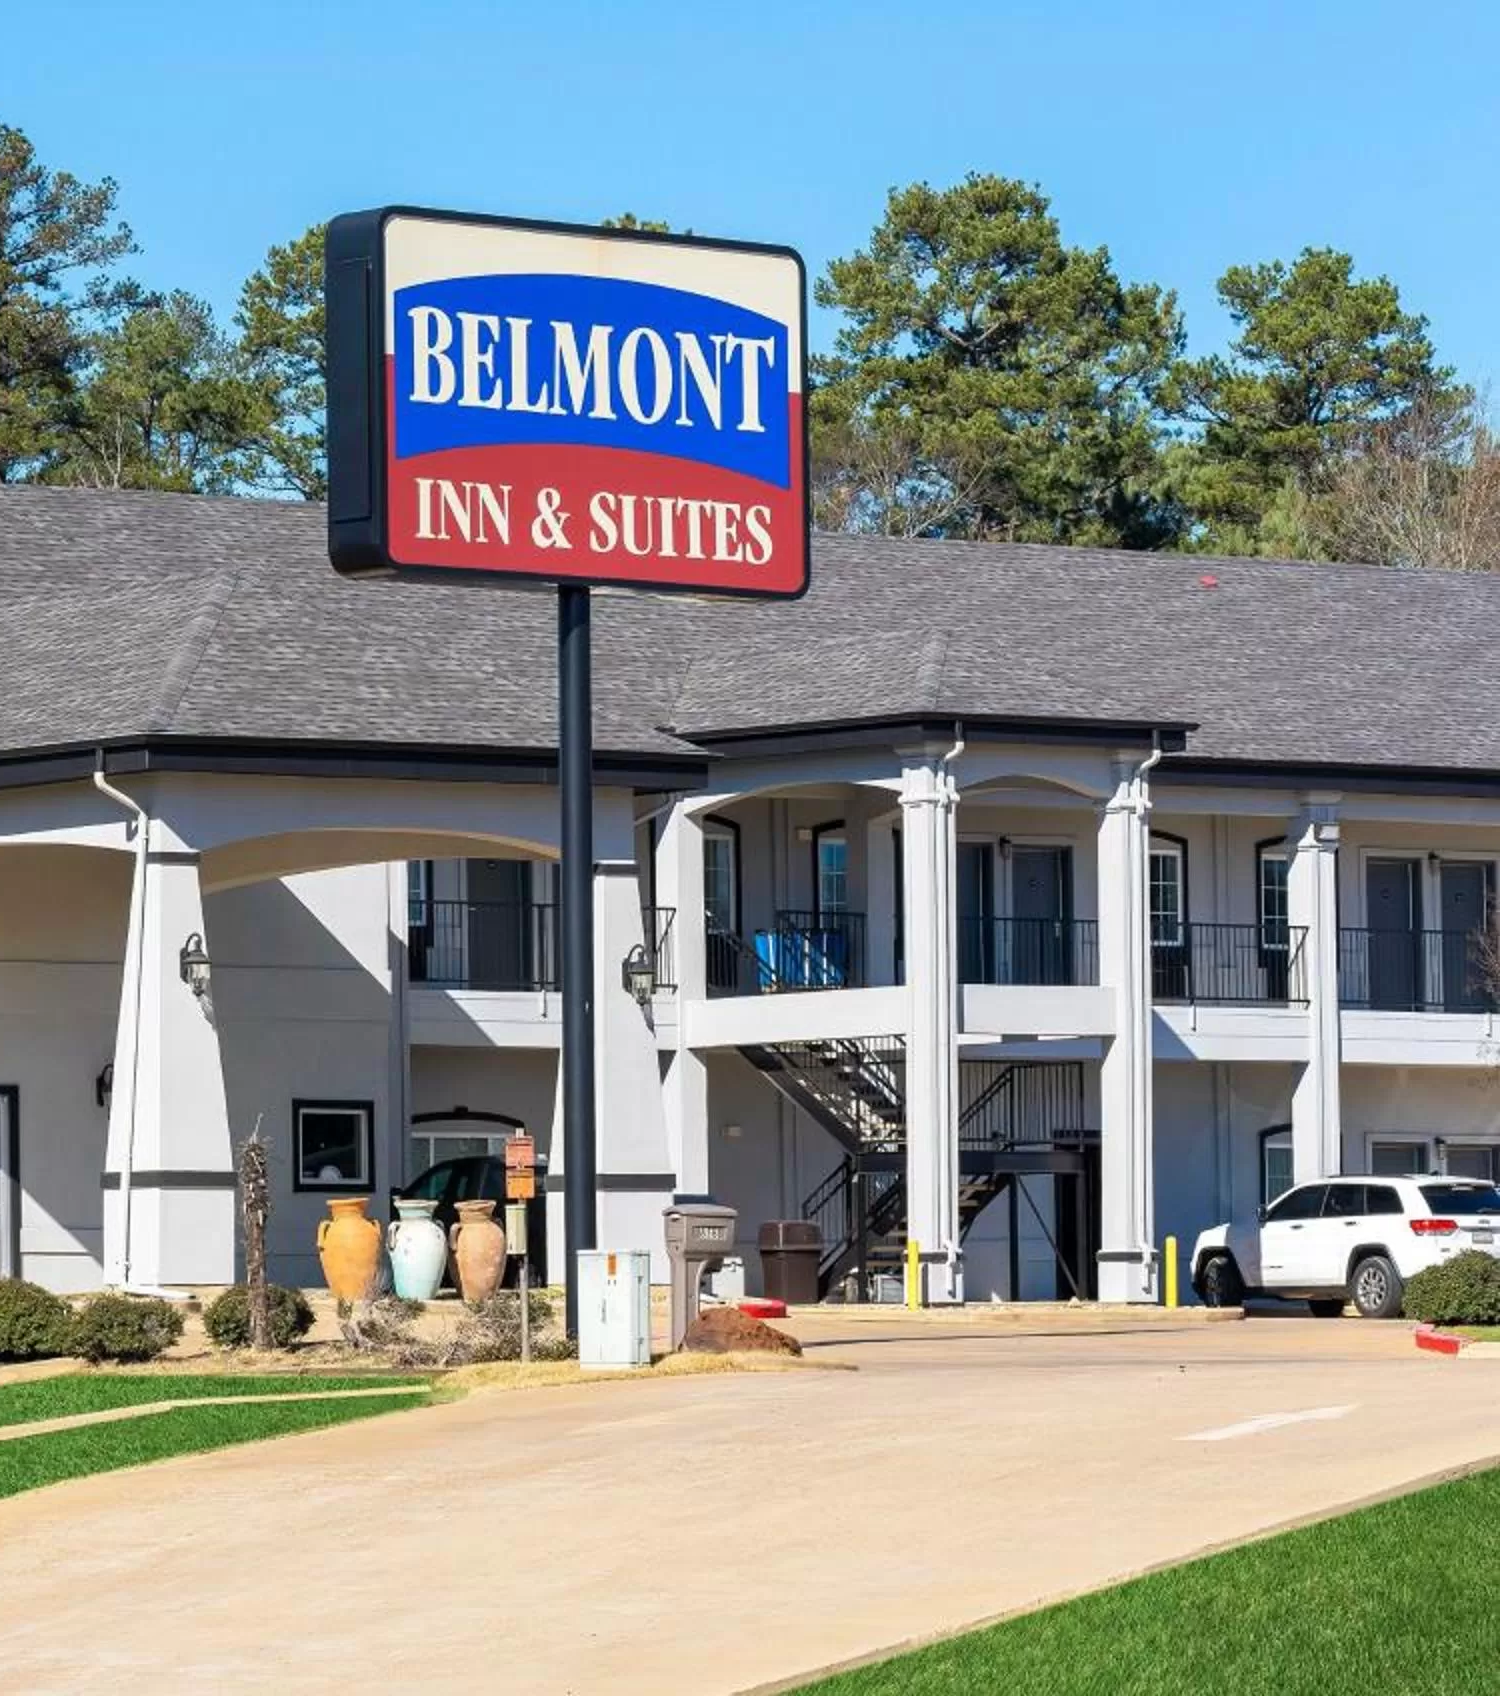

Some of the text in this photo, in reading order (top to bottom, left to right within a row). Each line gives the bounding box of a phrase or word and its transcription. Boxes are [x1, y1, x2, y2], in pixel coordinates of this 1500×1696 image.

[408, 305, 775, 433] BELMONT
[415, 477, 773, 565] INN & SUITES
